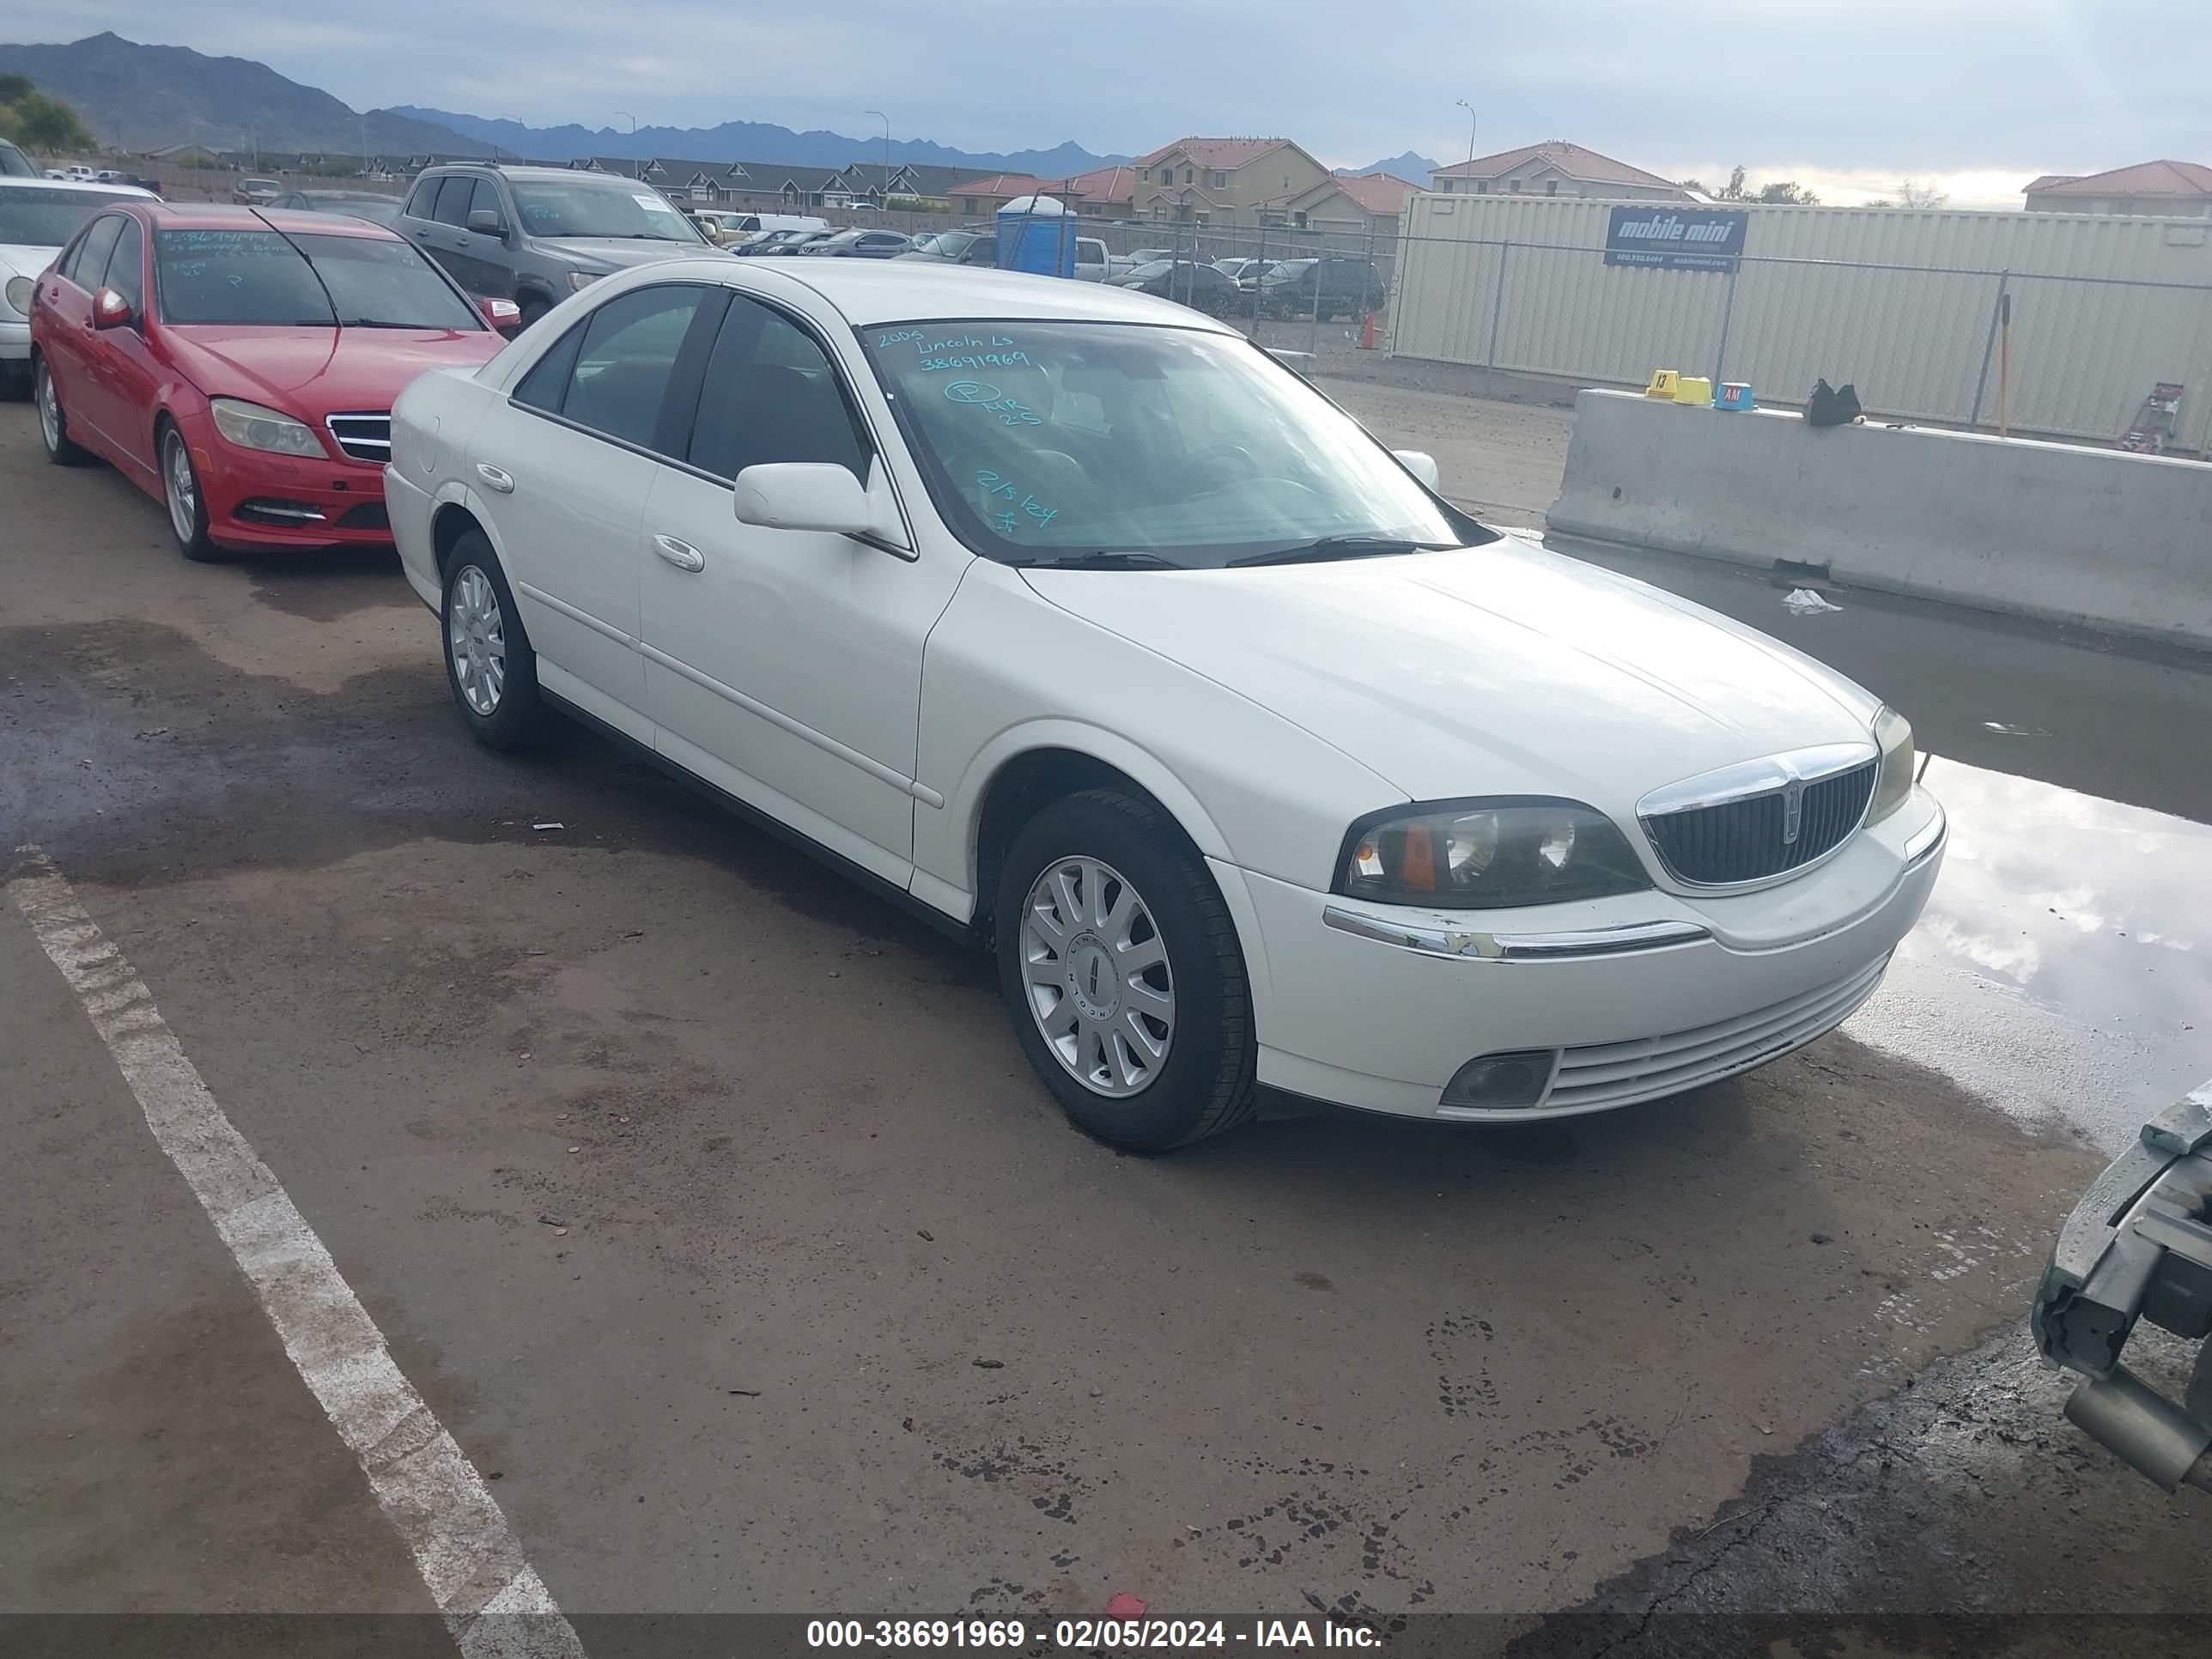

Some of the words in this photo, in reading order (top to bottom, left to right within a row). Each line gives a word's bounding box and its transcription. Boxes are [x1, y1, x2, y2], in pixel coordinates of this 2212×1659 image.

[1618, 215, 1685, 240] mobile
[1684, 220, 1735, 242] mini
[879, 331, 924, 348] 2005
[916, 336, 982, 354] Lincoln
[921, 351, 1030, 371] 38691969
[1656, 374, 1668, 388] 13
[1724, 389, 1741, 401] AM
